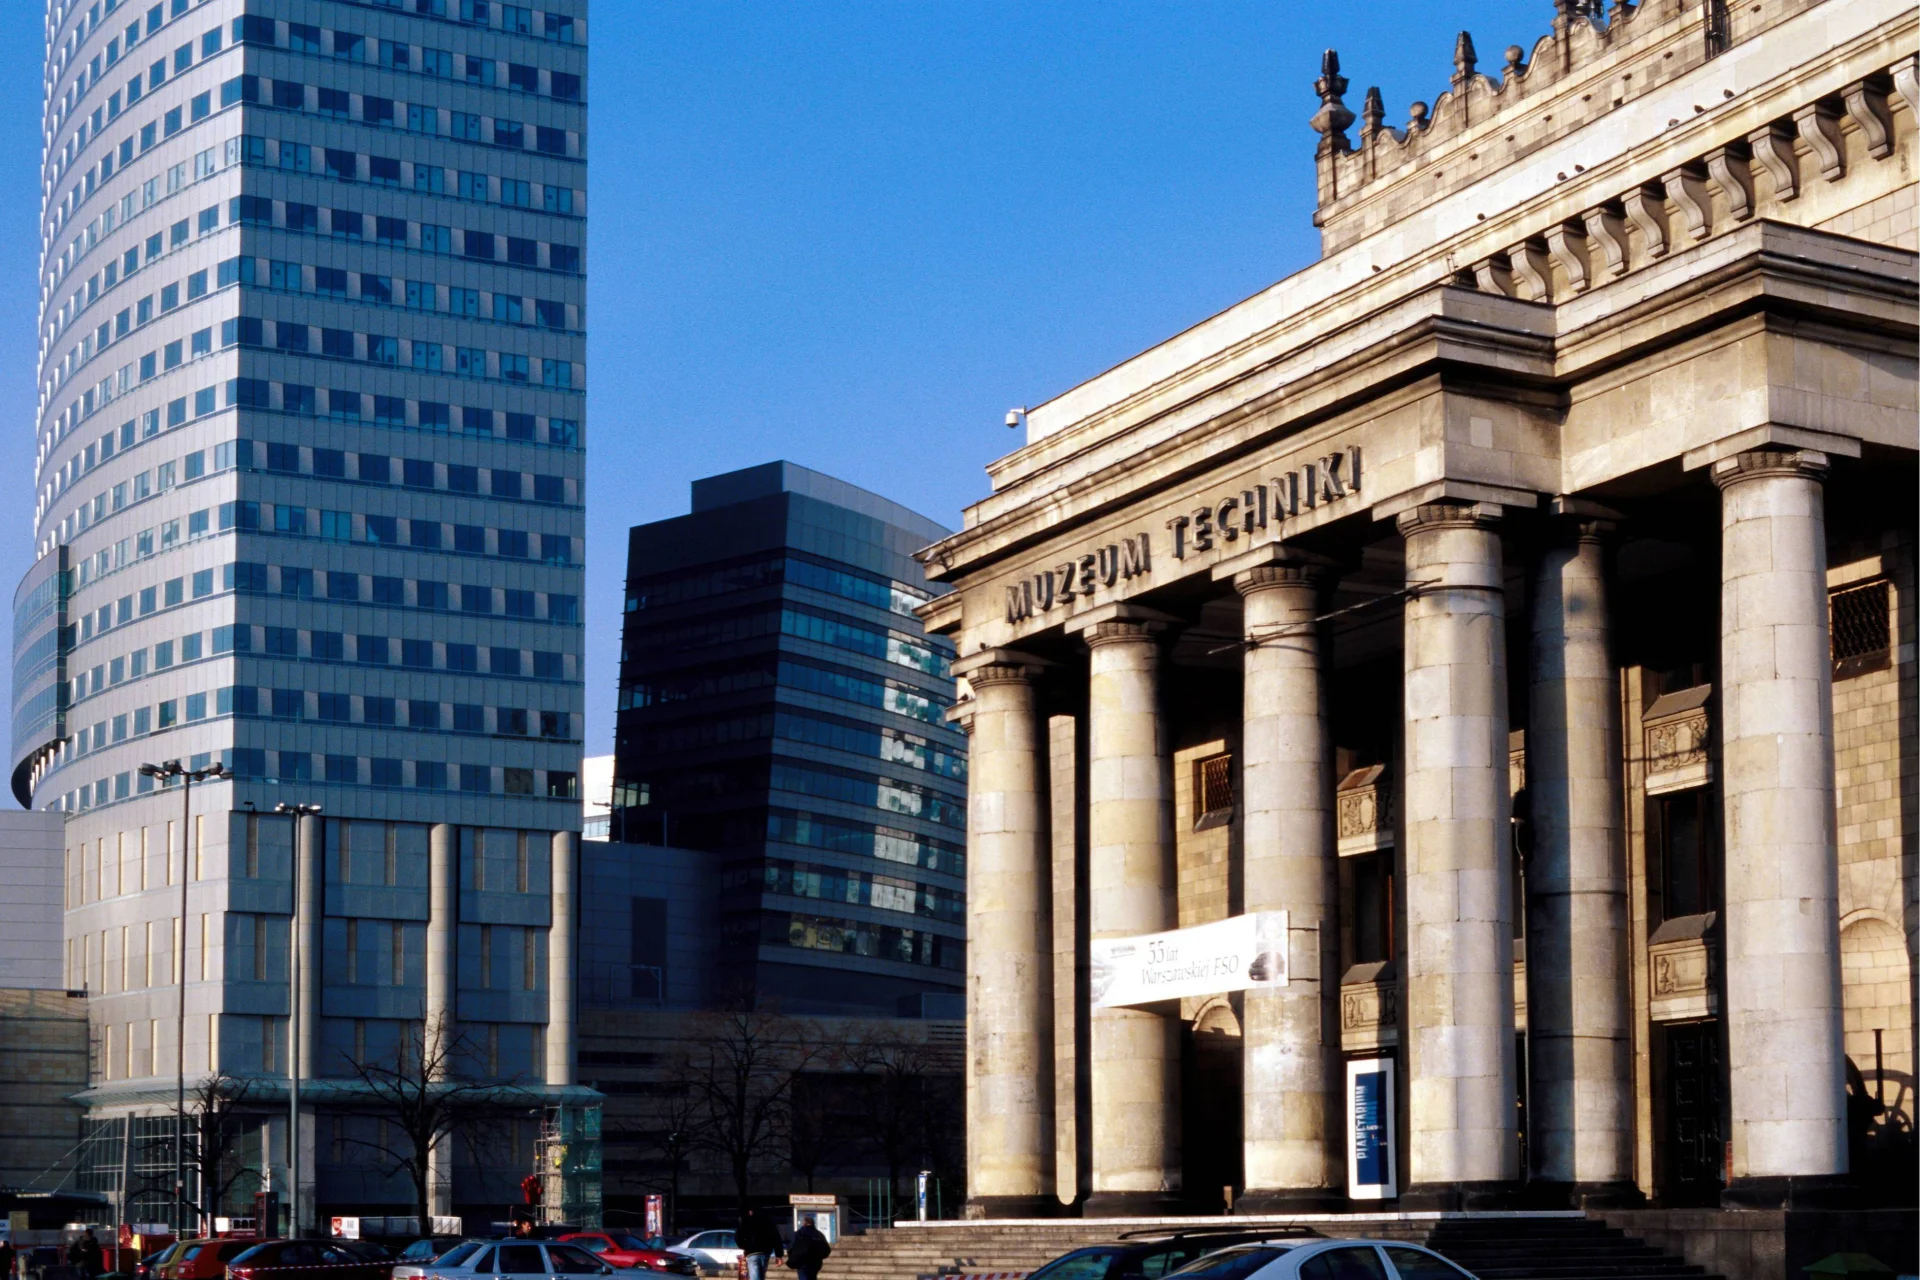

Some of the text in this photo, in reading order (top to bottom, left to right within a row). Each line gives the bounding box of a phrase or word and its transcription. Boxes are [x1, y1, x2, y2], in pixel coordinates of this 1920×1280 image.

[1005, 445, 1361, 624] MUZEUM TECHNIKI
[1148, 940, 1165, 965] 55
[1166, 946, 1178, 962] lat
[1142, 954, 1239, 985] Warszawskiej FSO
